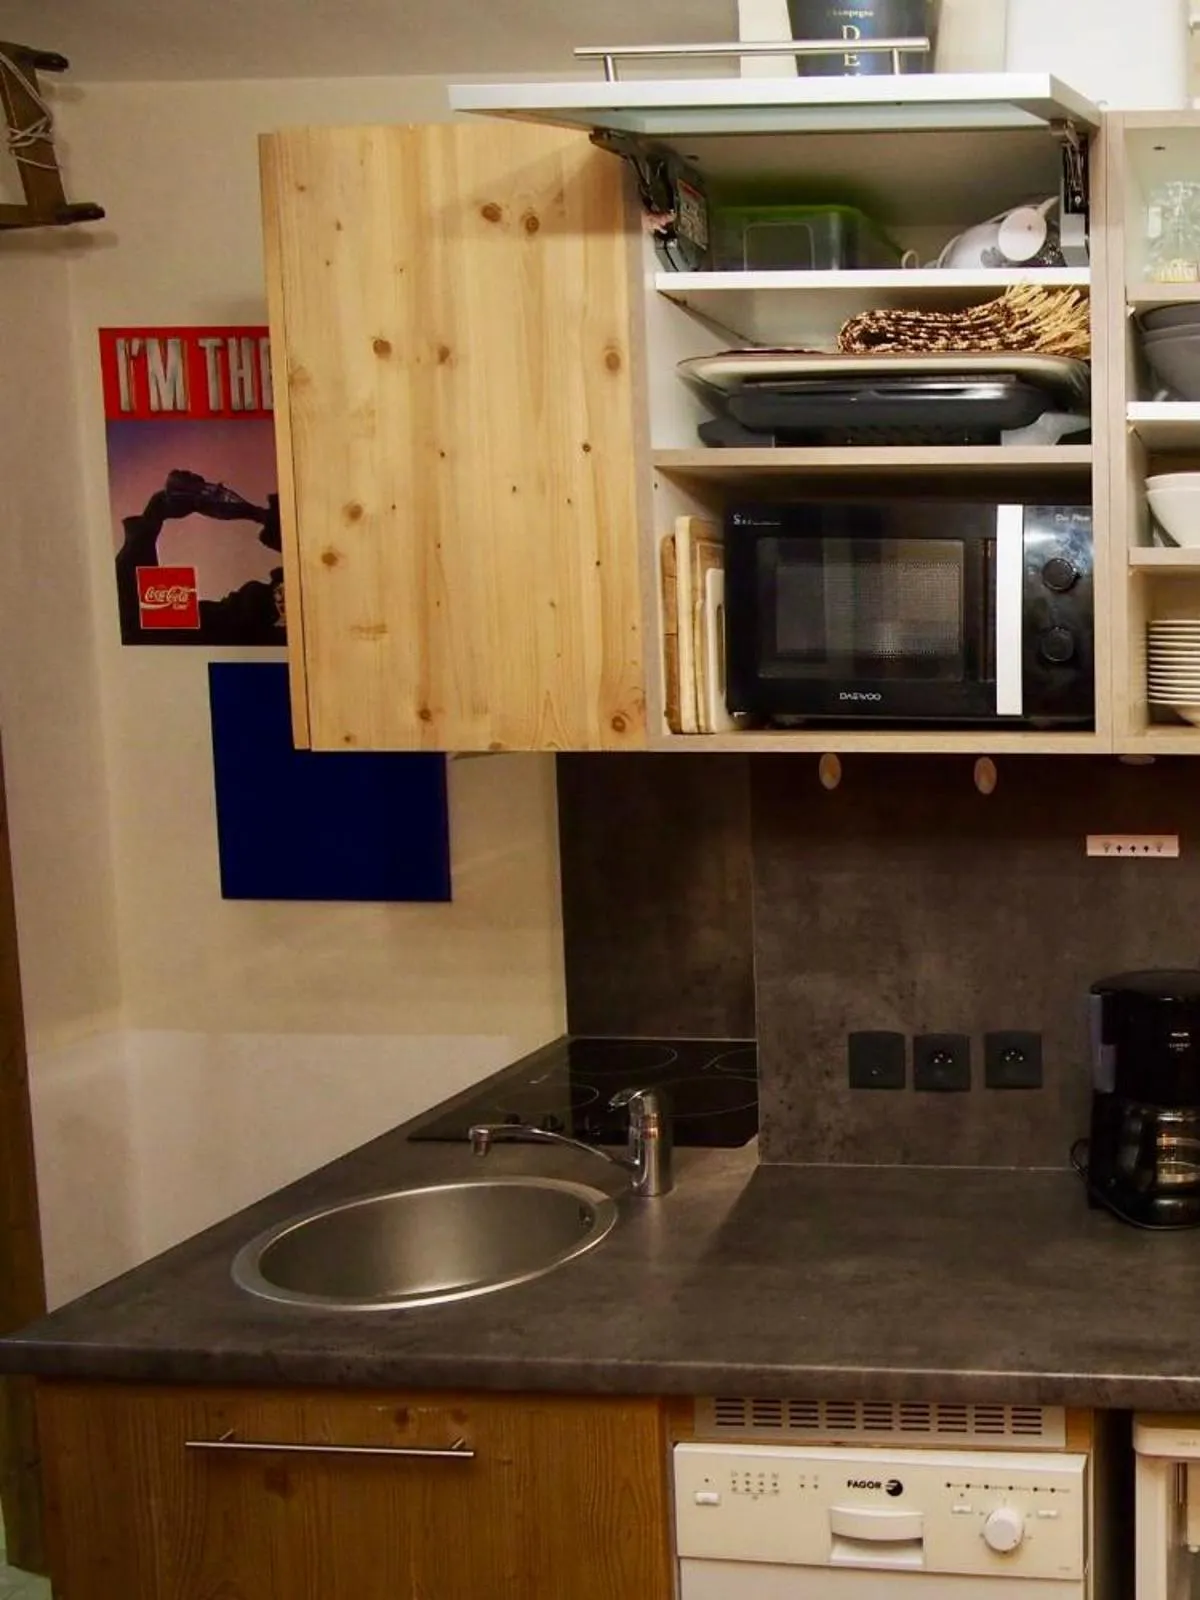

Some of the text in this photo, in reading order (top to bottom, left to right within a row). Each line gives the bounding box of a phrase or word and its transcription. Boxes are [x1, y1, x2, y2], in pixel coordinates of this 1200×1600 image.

[116, 337, 189, 412] I'M
[839, 691, 882, 701] DAEWOO
[847, 1479, 882, 1489] FAGOR
